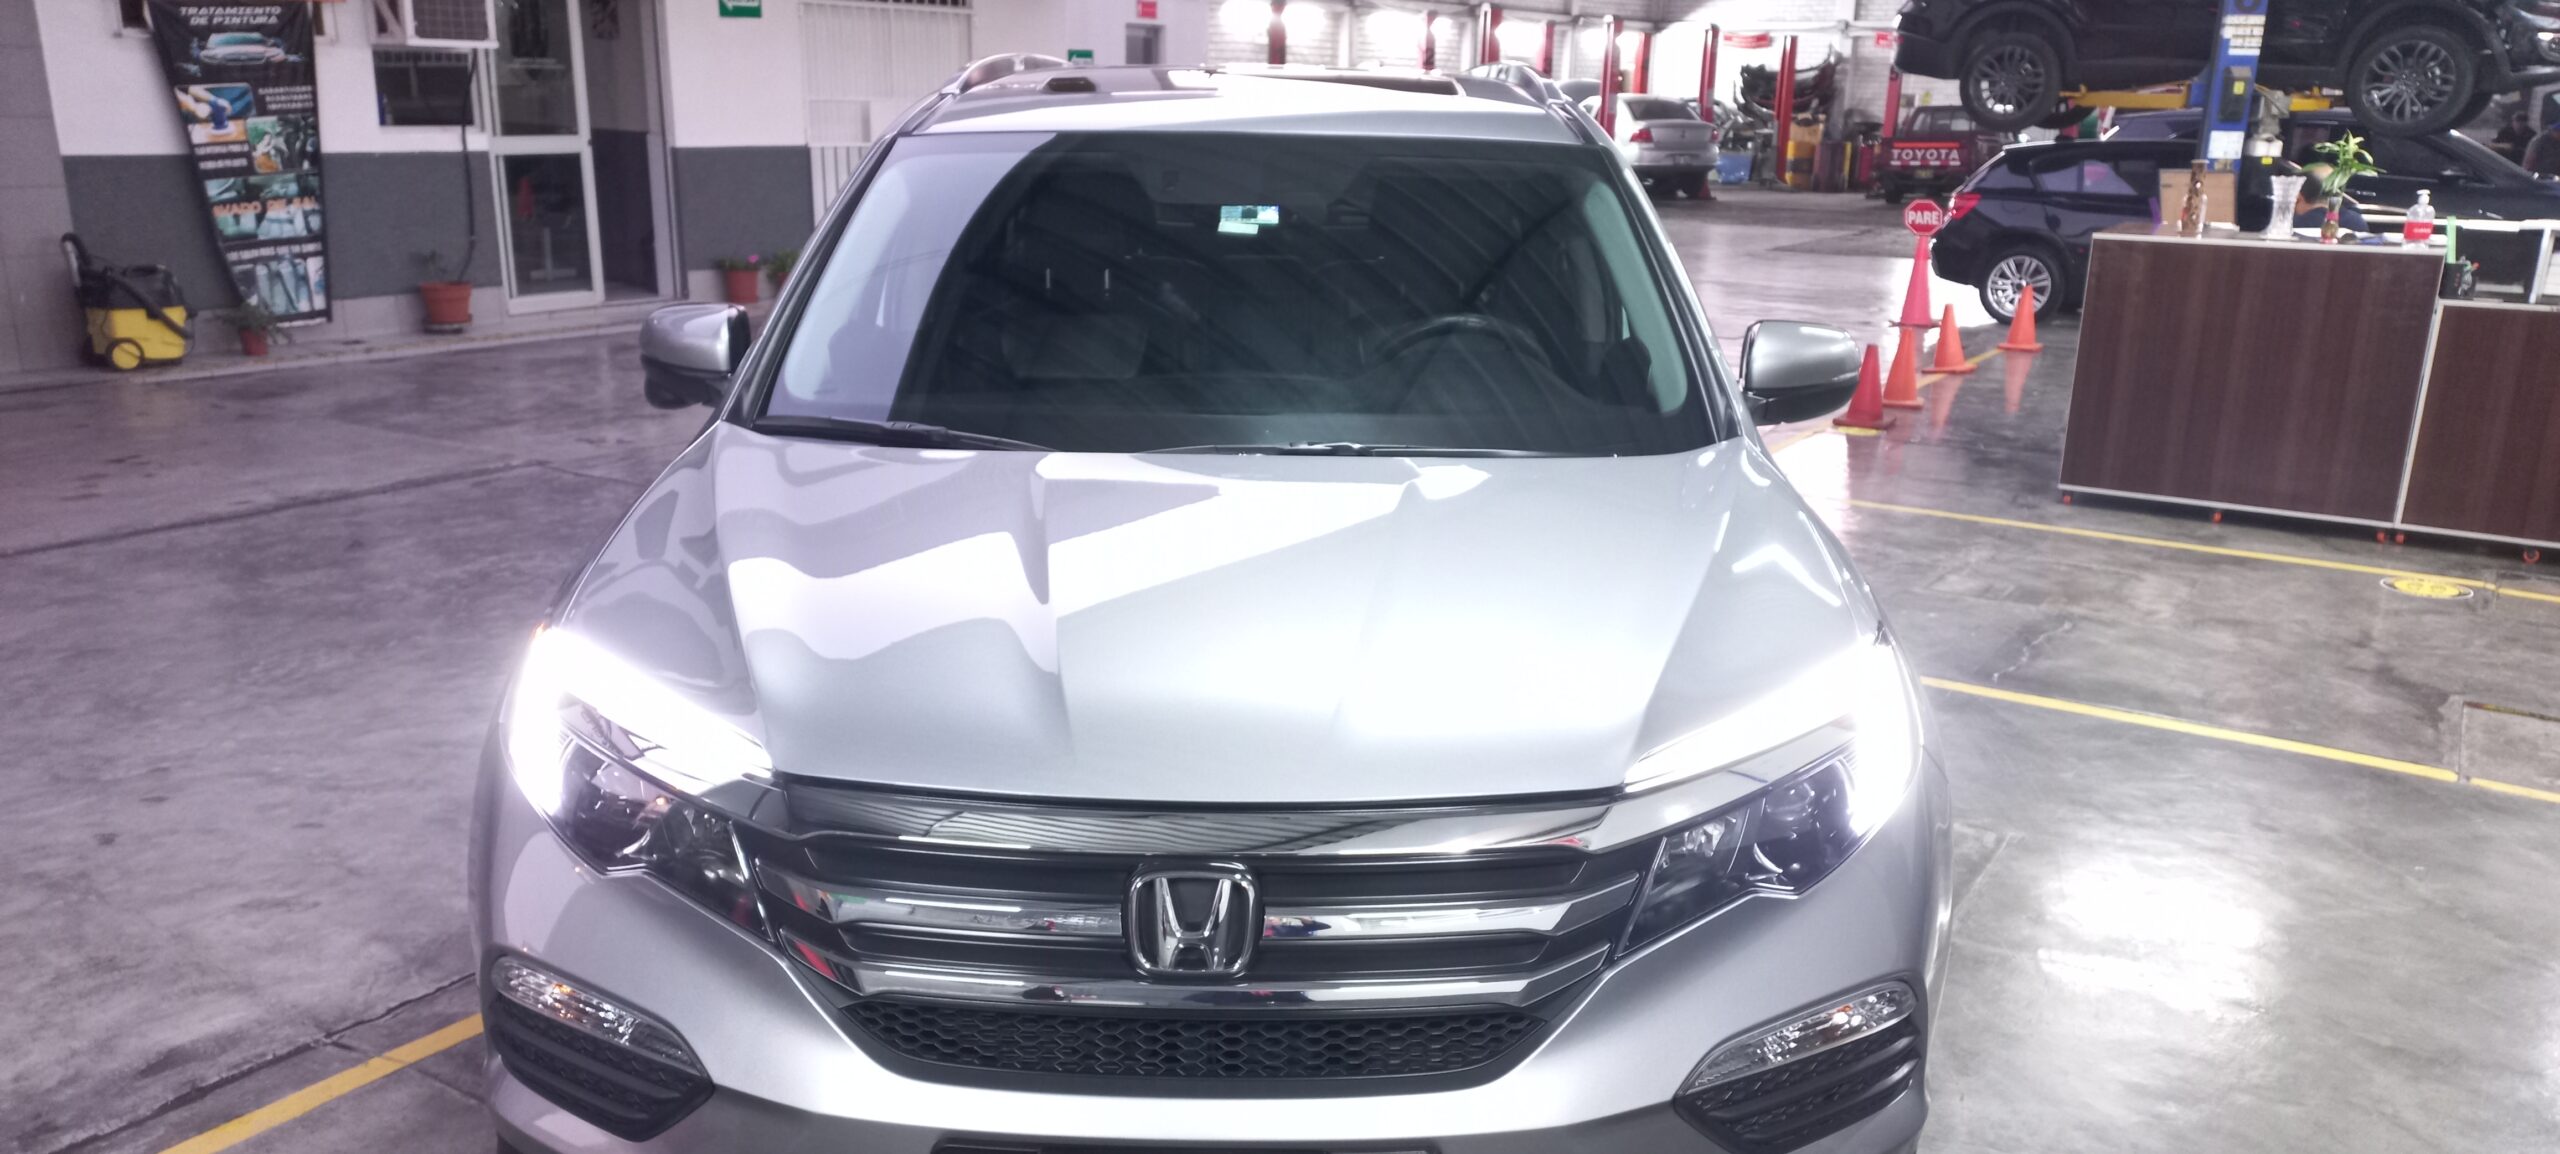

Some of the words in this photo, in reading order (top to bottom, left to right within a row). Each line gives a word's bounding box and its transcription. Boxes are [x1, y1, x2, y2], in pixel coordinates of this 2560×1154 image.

[179, 6, 281, 16] TRATAMIENTO
[190, 15, 209, 25] DE
[212, 15, 278, 25] PINTURA
[1892, 148, 1960, 160] TOYOTA
[1907, 210, 1940, 225] PARE
